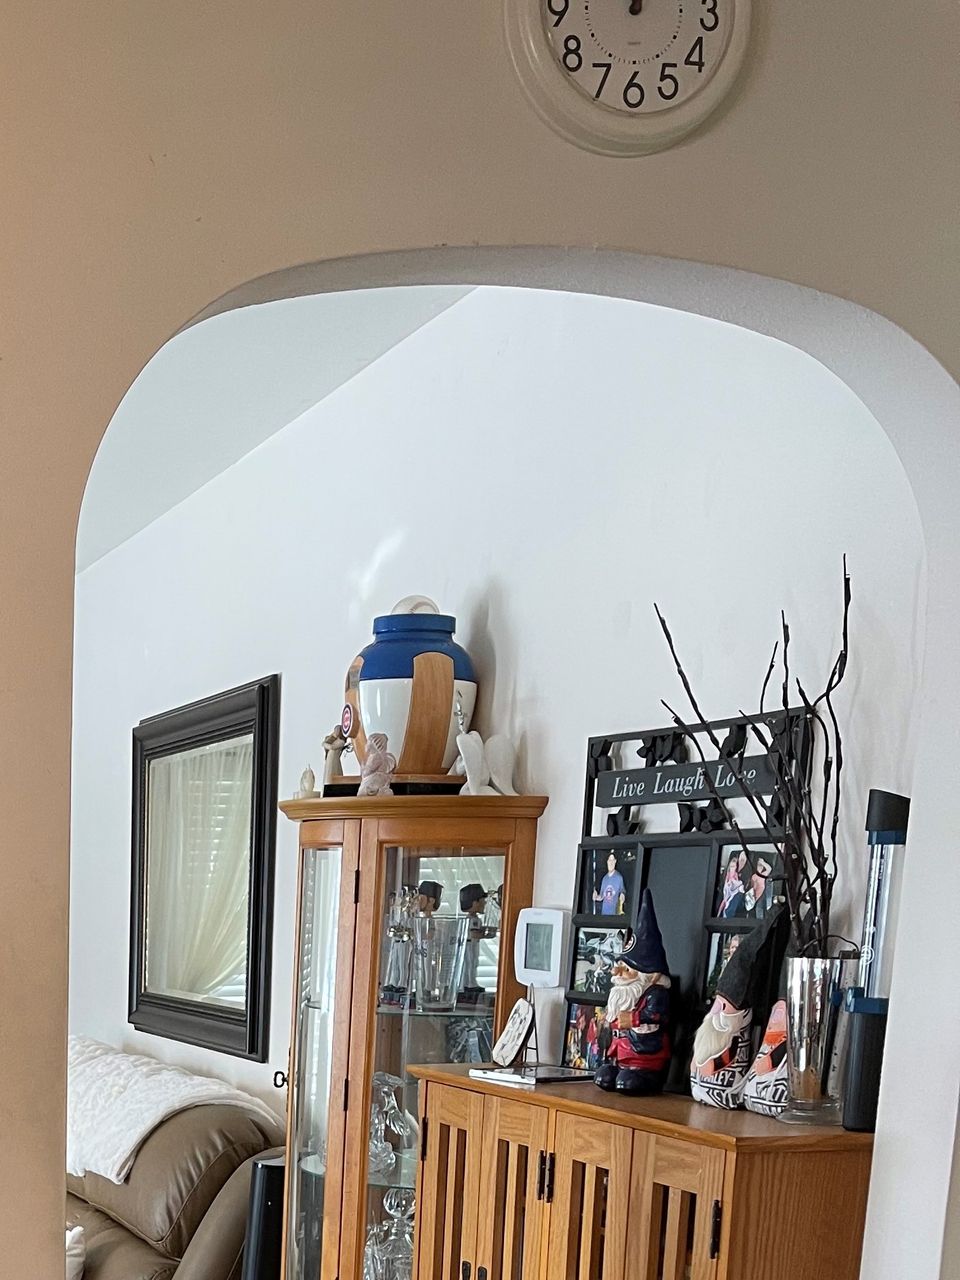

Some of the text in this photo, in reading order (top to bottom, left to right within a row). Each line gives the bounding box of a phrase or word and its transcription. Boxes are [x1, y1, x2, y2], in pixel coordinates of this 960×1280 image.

[547, 0, 569, 27] 9
[700, 0, 719, 31] 3
[562, 35, 583, 72] 8
[684, 37, 705, 73] 4
[592, 63, 611, 98] 7
[623, 71, 645, 108] 6
[657, 63, 678, 100] 5
[612, 764, 756, 798] Live Laugh Loe
